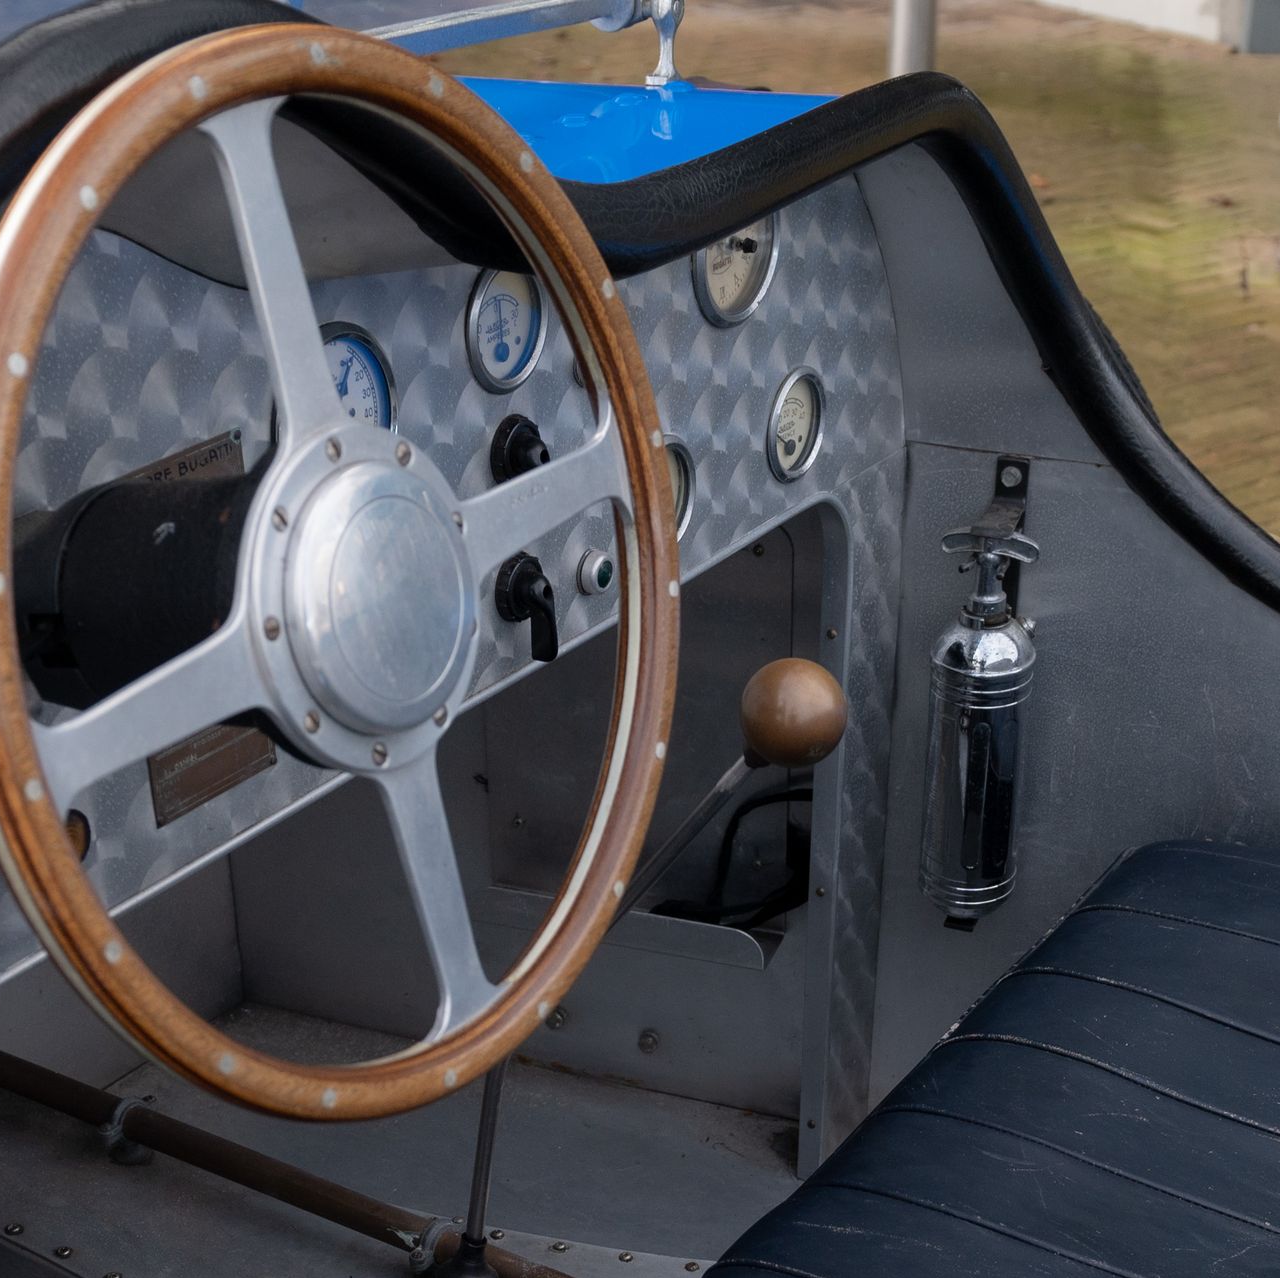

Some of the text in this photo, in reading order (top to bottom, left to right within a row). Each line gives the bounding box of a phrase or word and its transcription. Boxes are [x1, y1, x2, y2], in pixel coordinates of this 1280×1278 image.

[354, 370, 364, 382] 20
[362, 387, 372, 399] 30
[178, 443, 233, 476] BUGATTI
